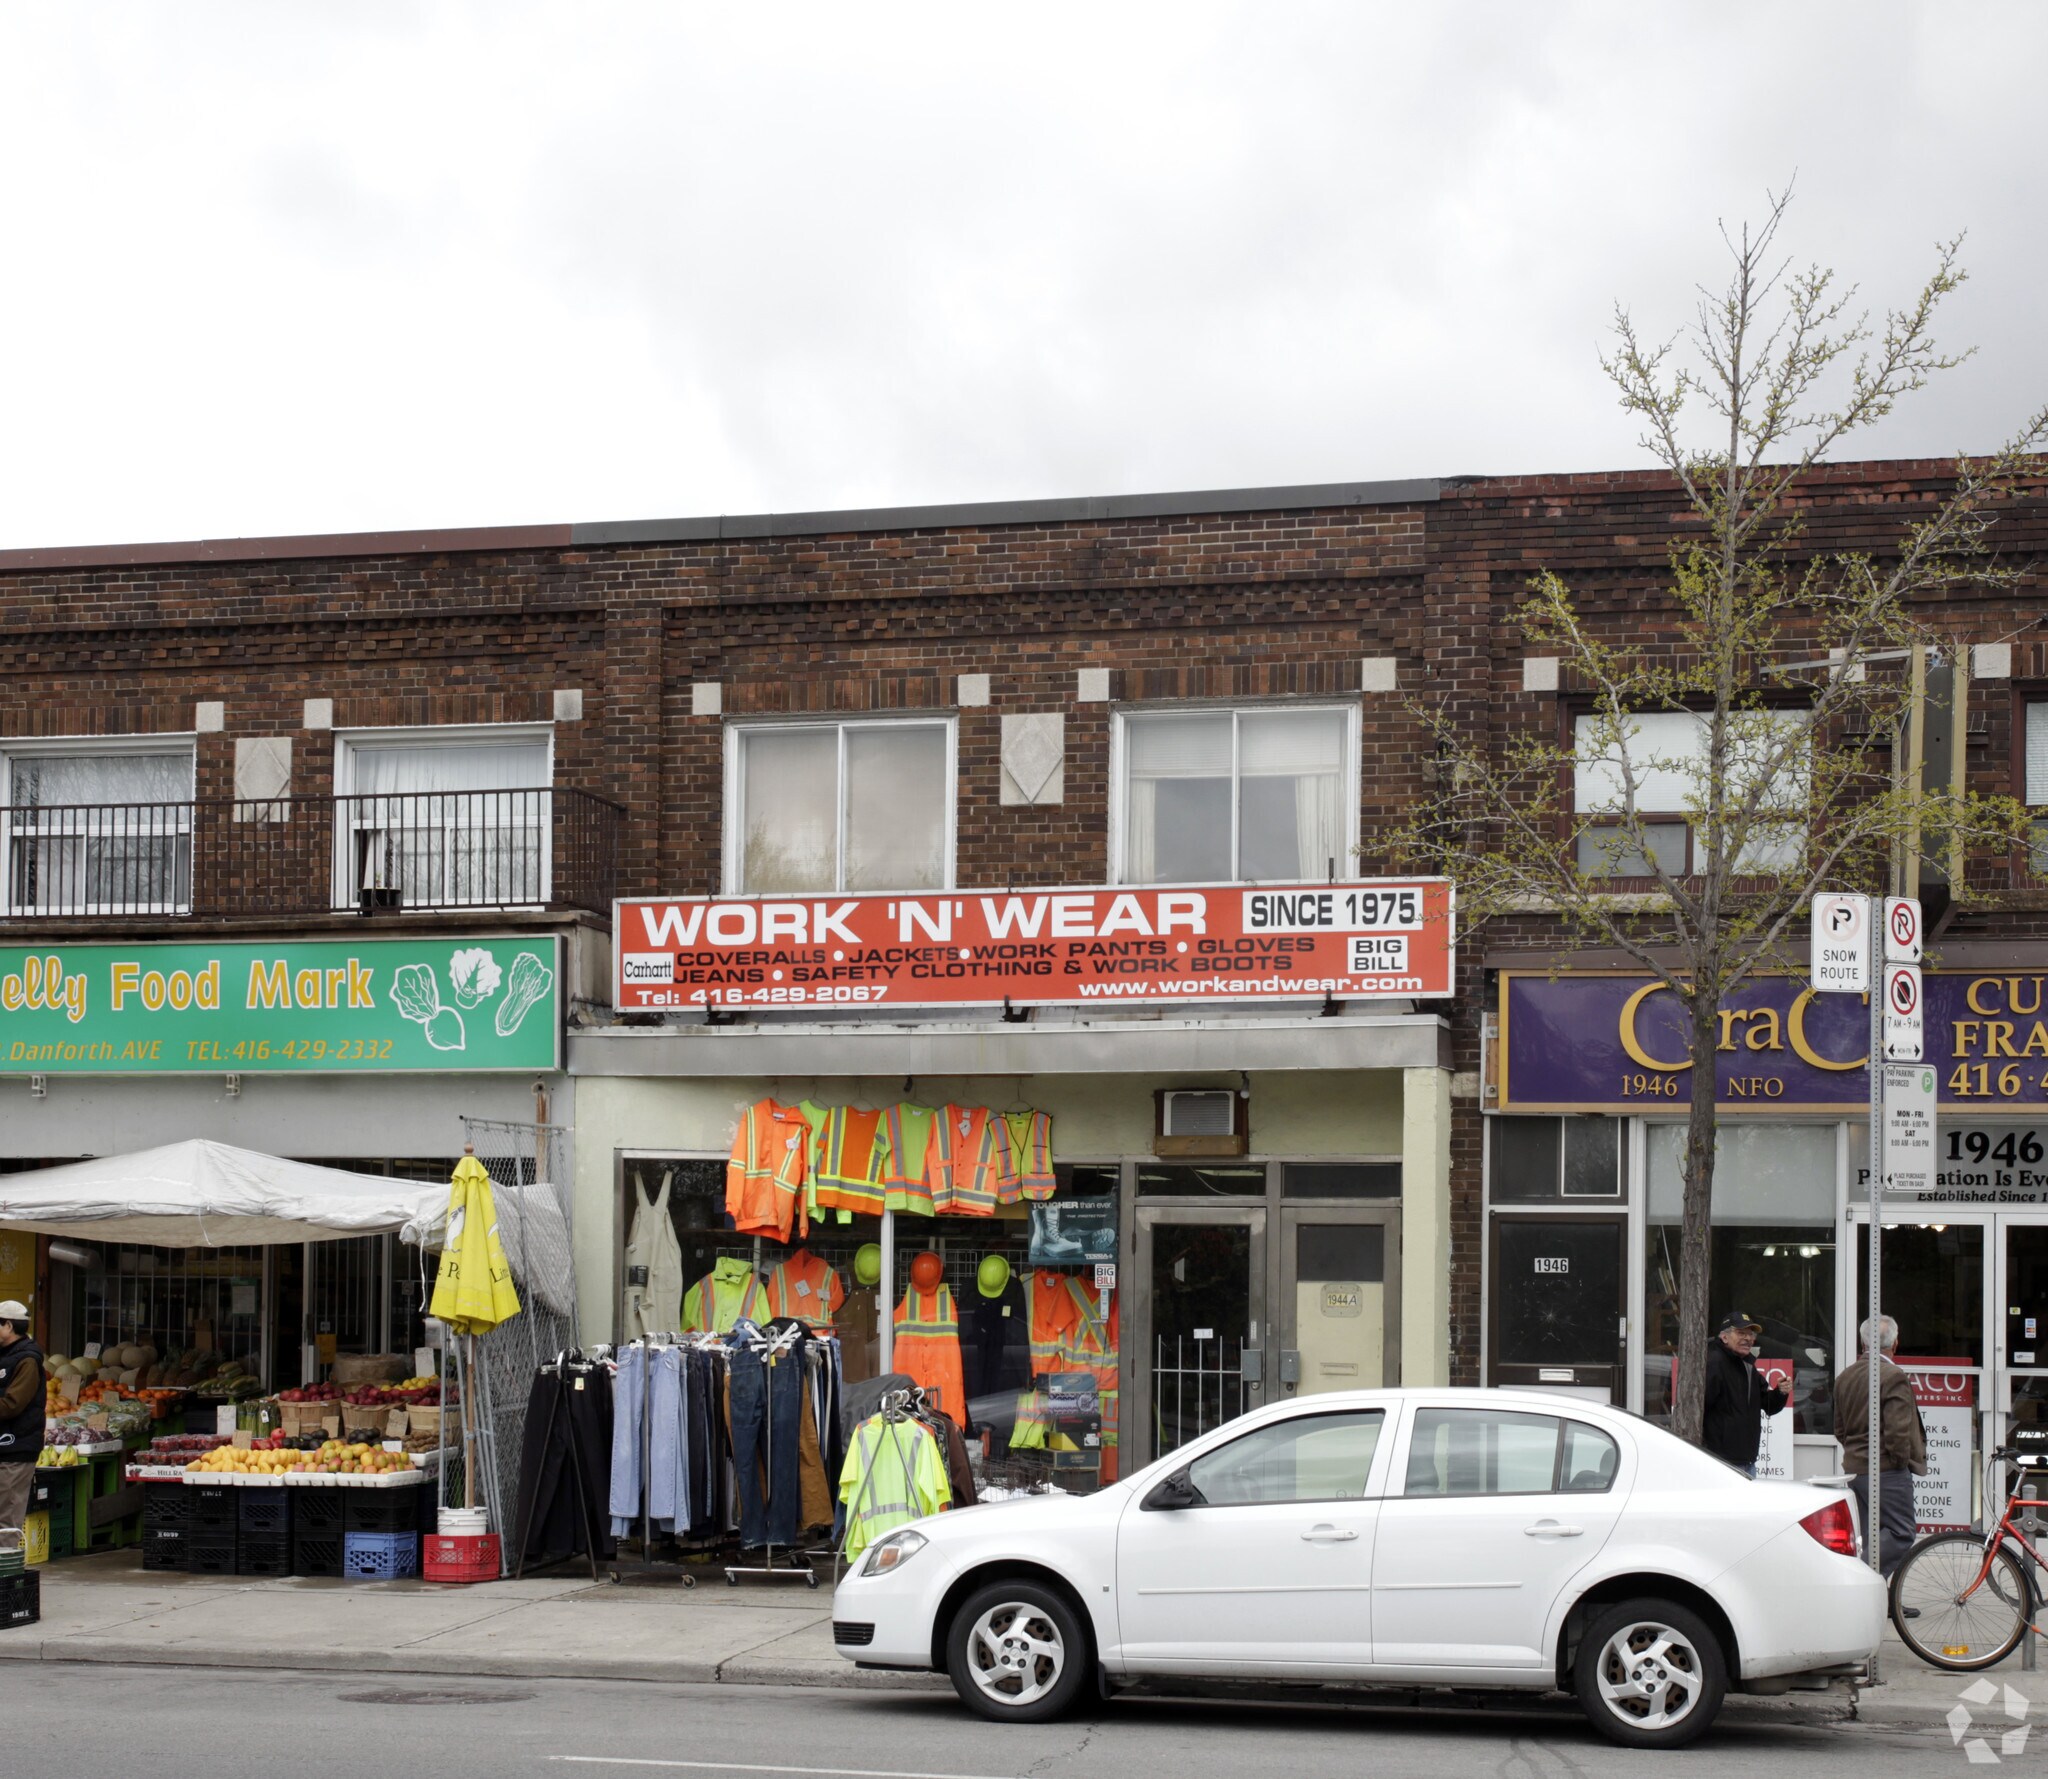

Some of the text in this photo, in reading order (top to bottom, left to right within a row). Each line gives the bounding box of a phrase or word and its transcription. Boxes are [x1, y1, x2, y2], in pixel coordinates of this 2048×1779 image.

[1250, 892, 1415, 927] SINCE 1975
[640, 892, 1207, 947] WORK 'N' WEAR
[677, 937, 1315, 967] COVERALLS JACKETS WORK PANTS GLOVES
[1354, 939, 1403, 955] BIG
[1823, 949, 1857, 962] SNOW
[624, 959, 673, 979] Carhartt
[673, 955, 1293, 984] JEANS SAFETY CLOTHING & WORK BOOTS
[1354, 956, 1404, 971] BILL
[1820, 967, 1859, 980] ROUTE
[111, 959, 220, 1011] Food
[246, 957, 376, 1010] Mark
[1078, 974, 1423, 997] www.workandwear.com
[636, 985, 888, 1006] Tel: 416-429-2067
[1887, 1016, 1892, 1028] 7
[1893, 1019, 1901, 1028] AM
[1913, 1020, 1920, 1029] AM
[1896, 1069, 1915, 1078] PARKING
[1621, 1074, 1678, 1097] 1946
[1886, 1079, 1910, 1088] ENFORCED
[1897, 1110, 1910, 1118] MON
[1914, 1110, 1924, 1119] FRI
[1946, 1131, 2044, 1168] 1946
[1995, 1169, 2012, 1186] Is
[1917, 1190, 1996, 1202] Established
[1999, 1190, 2036, 1202] Since
[1032, 1201, 1079, 1209] TOUGHER
[1096, 1267, 1114, 1276] BIG
[1536, 1259, 1567, 1273] 1946
[1096, 1276, 1115, 1285] BILL
[1756, 1467, 1785, 1476] RAMES
[1922, 1496, 1952, 1506] DONE
